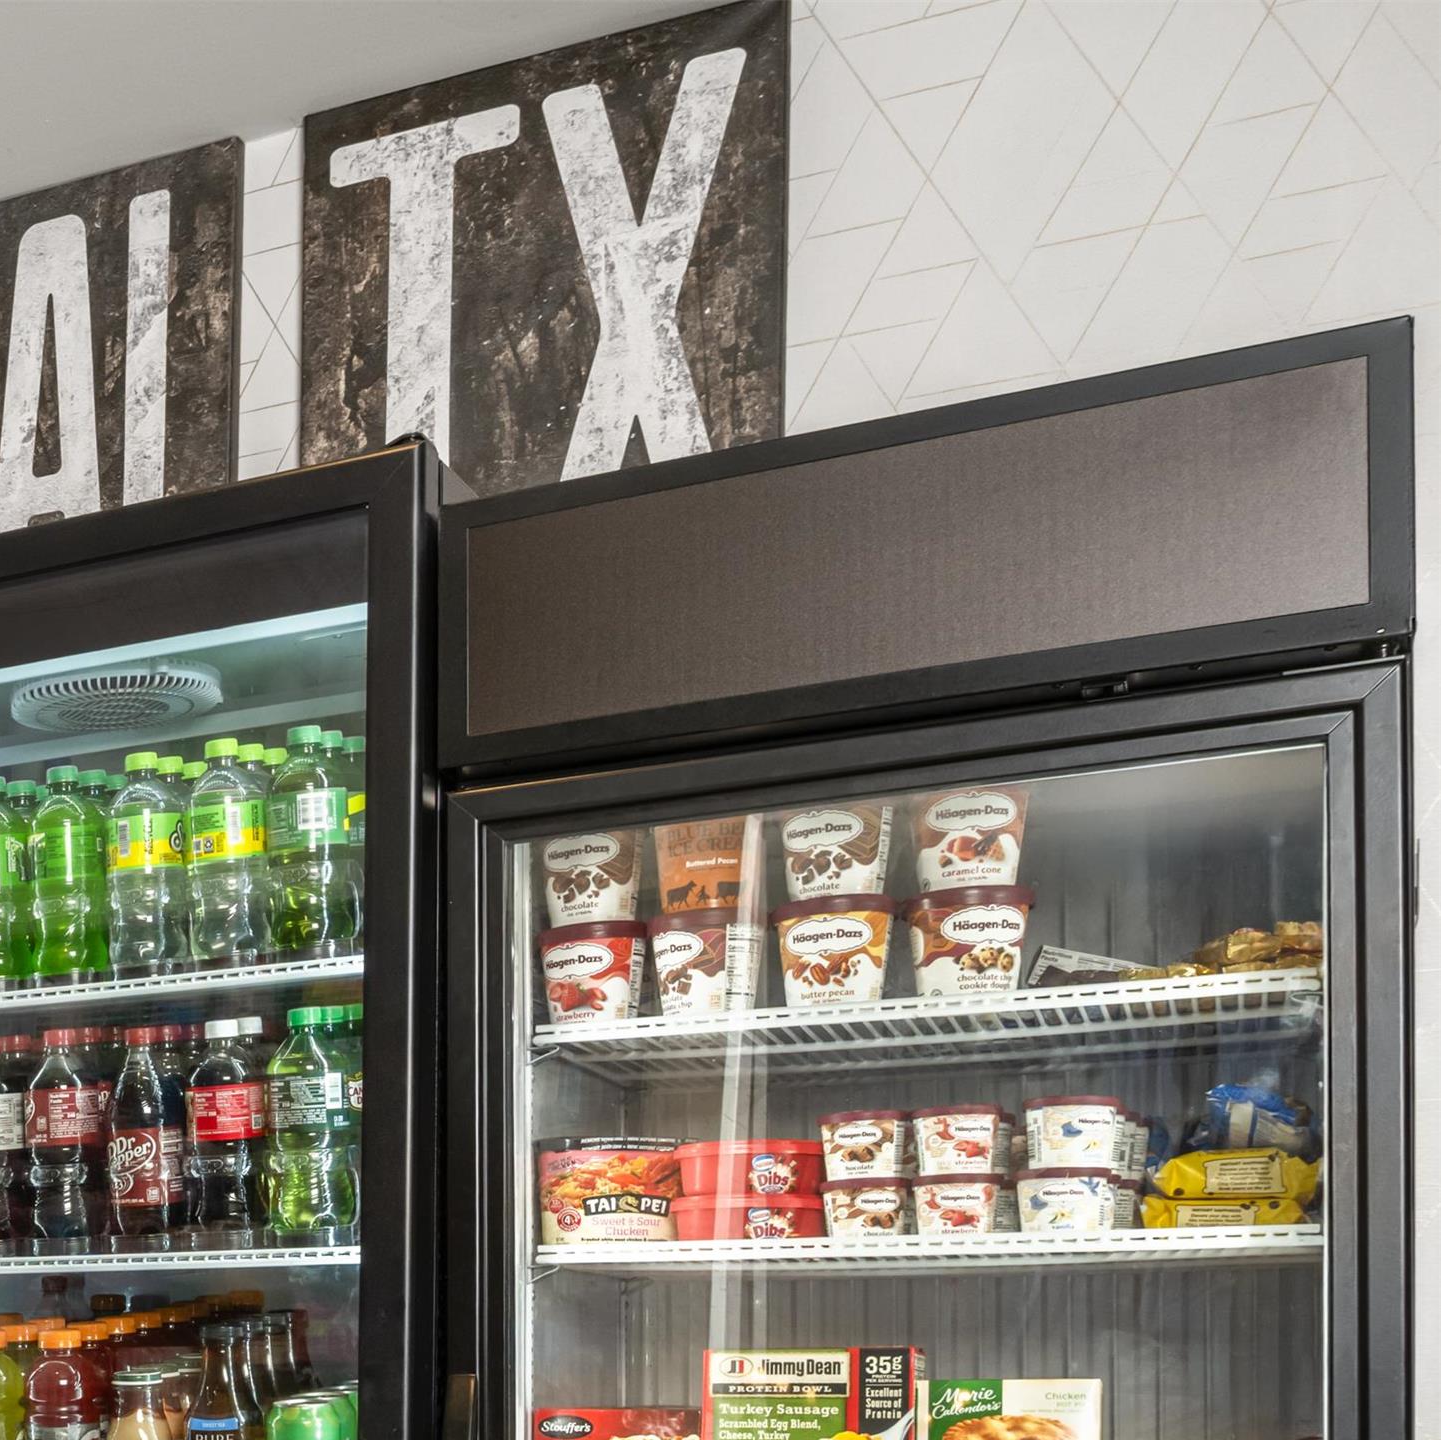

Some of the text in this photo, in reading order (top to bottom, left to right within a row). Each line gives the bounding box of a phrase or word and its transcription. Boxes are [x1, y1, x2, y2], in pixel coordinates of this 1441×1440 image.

[331, 48, 747, 480] TX
[936, 804, 1009, 820] Häagen-Dazs
[787, 822, 852, 839] Häagen-Dazs
[548, 844, 610, 861] Häagen-Dazs
[941, 866, 1002, 878] caramel cone
[799, 882, 839, 895] chocolate
[792, 929, 863, 944] Häagen-Dazs
[546, 954, 603, 970] Häagen-Dazs
[957, 973, 998, 982] chocolate
[801, 989, 825, 1000] butter
[116, 1137, 135, 1154] Dr
[757, 1174, 789, 1188] Dibs
[587, 1196, 667, 1214] TAI PEI
[591, 1216, 661, 1227] Sweet Sour
[605, 1226, 649, 1237] Chicken
[758, 1358, 841, 1377] Jimmy Dean
[865, 1355, 902, 1375] 35g
[728, 1385, 832, 1393] PROTEIN BOWL
[865, 1388, 902, 1398] Excellent
[942, 1387, 997, 1406] Marie
[1045, 1391, 1087, 1401] Chicken
[866, 1398, 892, 1408] Source
[720, 1404, 839, 1417] Turkey Sausage
[866, 1409, 902, 1419] Protein
[541, 1419, 591, 1436] Stouffer's
[719, 1419, 821, 1432] Scrambled Egg Blend,
